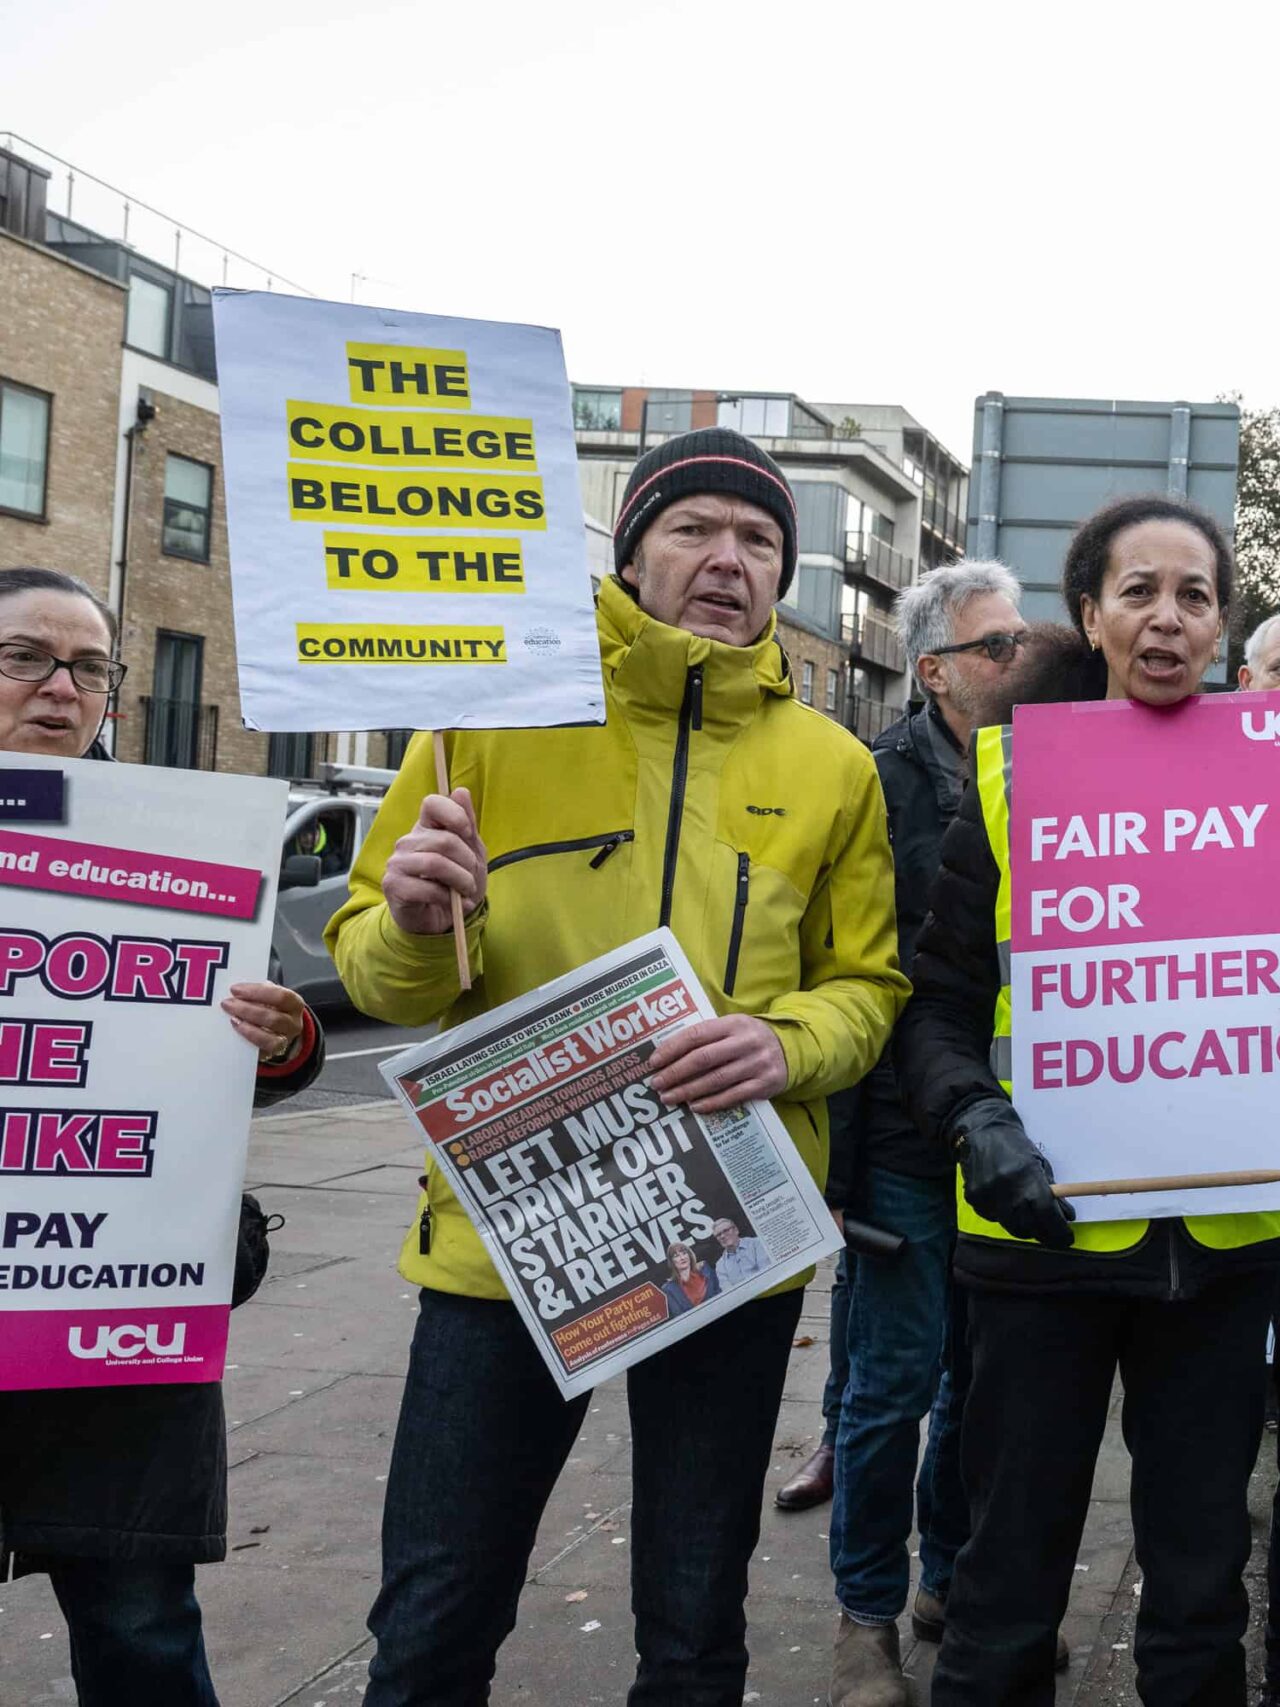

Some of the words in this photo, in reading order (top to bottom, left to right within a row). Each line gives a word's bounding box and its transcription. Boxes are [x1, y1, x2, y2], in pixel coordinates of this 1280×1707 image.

[347, 357, 470, 399] THE
[289, 416, 535, 461] COLLEGE
[290, 478, 545, 520] BELONGS
[325, 547, 398, 580] TO
[417, 550, 524, 583] THE
[298, 637, 505, 659] COMMUNITY
[1031, 811, 1150, 863] FAIR
[1163, 804, 1269, 852] PAY
[48, 859, 236, 904] education...
[1031, 884, 1144, 936] FOR
[425, 1064, 459, 1086] ISRAEL
[455, 1049, 488, 1071] LAYING
[486, 1037, 512, 1055] SIEGE
[511, 1031, 525, 1043] TO
[524, 1019, 549, 1036] WEST
[548, 1007, 572, 1025] BANK
[579, 990, 605, 1008] MORE
[603, 973, 639, 996] MURDER
[638, 969, 648, 979] IN
[647, 958, 669, 974] GAZA
[442, 1031, 587, 1125] Socialist
[576, 979, 692, 1057] Worker
[460, 1119, 507, 1150] LABOUR
[504, 1095, 555, 1128] HEADING
[552, 1069, 606, 1103] TOWARDS
[603, 1051, 641, 1077] ABYSS
[467, 1132, 510, 1161] RACIST
[506, 1111, 553, 1142] REFORM
[550, 1103, 569, 1120] UK
[565, 1080, 613, 1112] WAITING
[611, 1073, 626, 1088] IN
[711, 1133, 724, 1143] New
[722, 1119, 751, 1138] challenge
[728, 1128, 745, 1141] right
[463, 1127, 568, 1208] LEFT
[485, 1152, 614, 1244] DRIVE
[607, 1109, 699, 1182] OUT
[3, 1212, 109, 1249] PAY
[511, 1163, 696, 1280] STARMER
[533, 1276, 575, 1320] &
[563, 1199, 716, 1303] REEVES
[555, 1324, 581, 1346] How
[579, 1311, 606, 1332] Your
[603, 1295, 636, 1321] Party
[632, 1286, 654, 1304] can
[562, 1335, 594, 1358] come
[591, 1325, 611, 1342] out
[608, 1302, 652, 1334] fighting
[68, 1323, 187, 1359] UCU
[105, 1357, 141, 1367] University
[142, 1357, 155, 1365] and
[156, 1356, 183, 1364] College
[183, 1355, 204, 1364] Union
[568, 1351, 590, 1367] Analysis
[596, 1330, 627, 1351] conference
